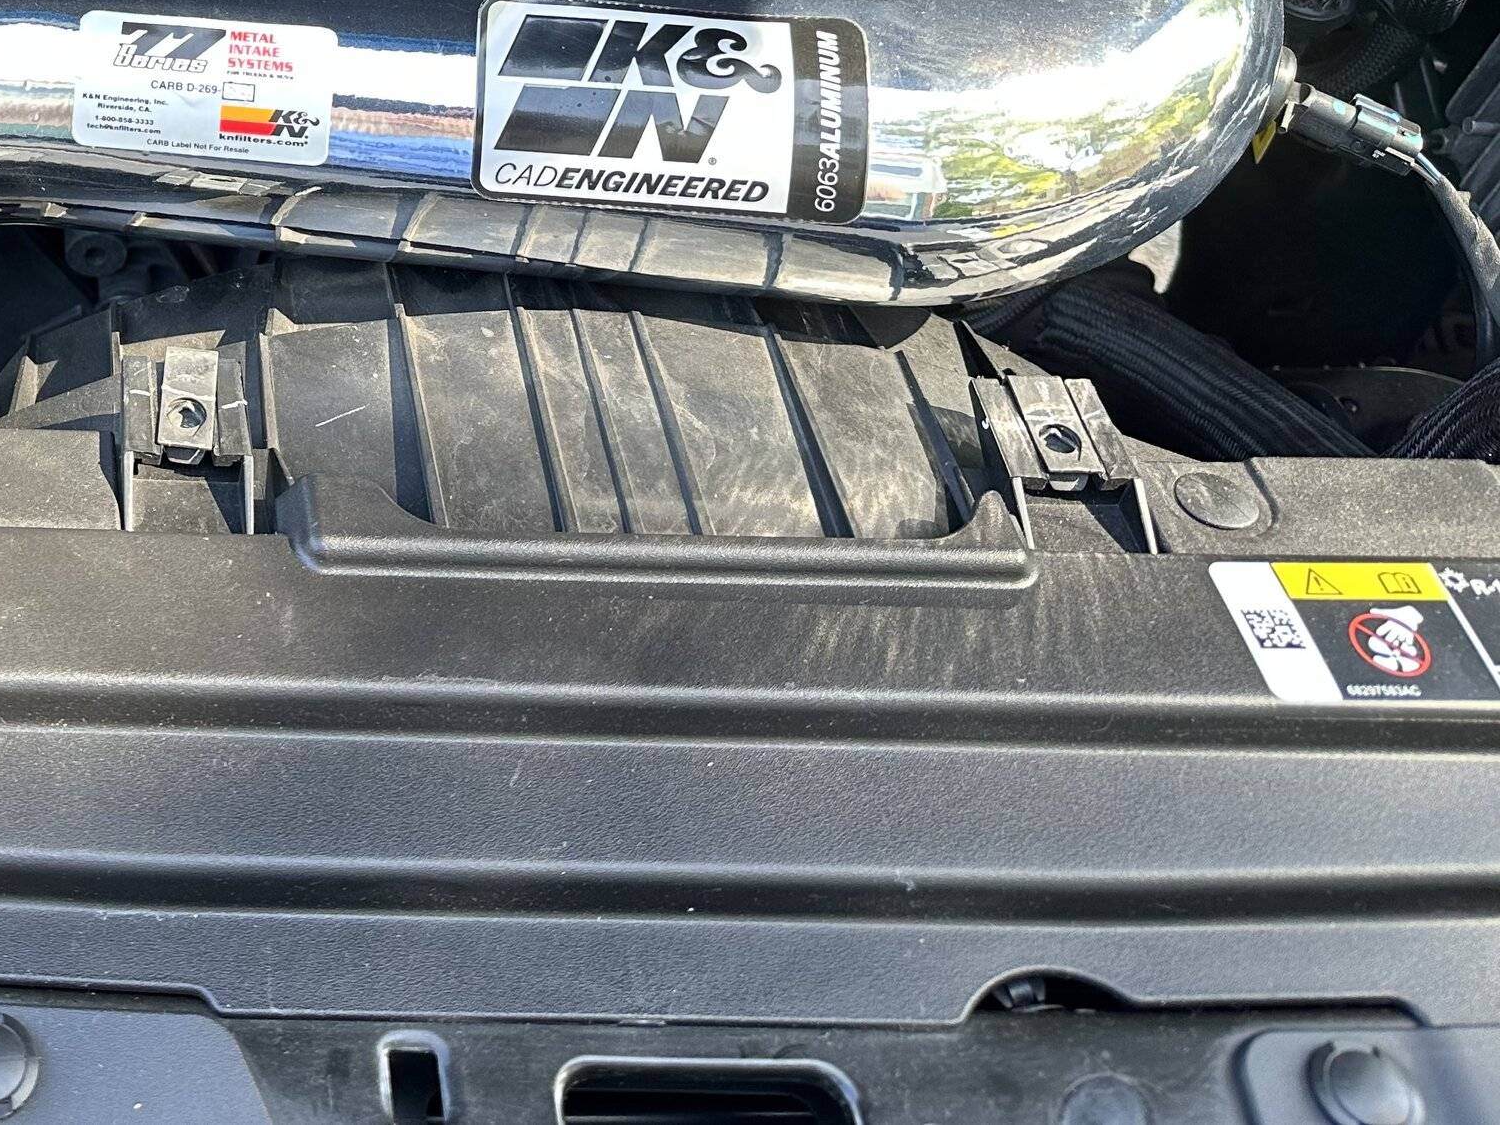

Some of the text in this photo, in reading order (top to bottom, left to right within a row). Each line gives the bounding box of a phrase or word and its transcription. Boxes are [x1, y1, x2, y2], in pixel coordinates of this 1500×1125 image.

[230, 30, 275, 44] METAL
[229, 44, 280, 57] INTAKE
[227, 57, 293, 73] SYSTEMS
[150, 80, 183, 91] CARB
[82, 92, 169, 106] K&N Engineering, Inc.
[97, 103, 152, 113] Riverside, CA.
[146, 138, 169, 147] CARB
[171, 140, 192, 149] Label
[223, 146, 250, 154] Resale
